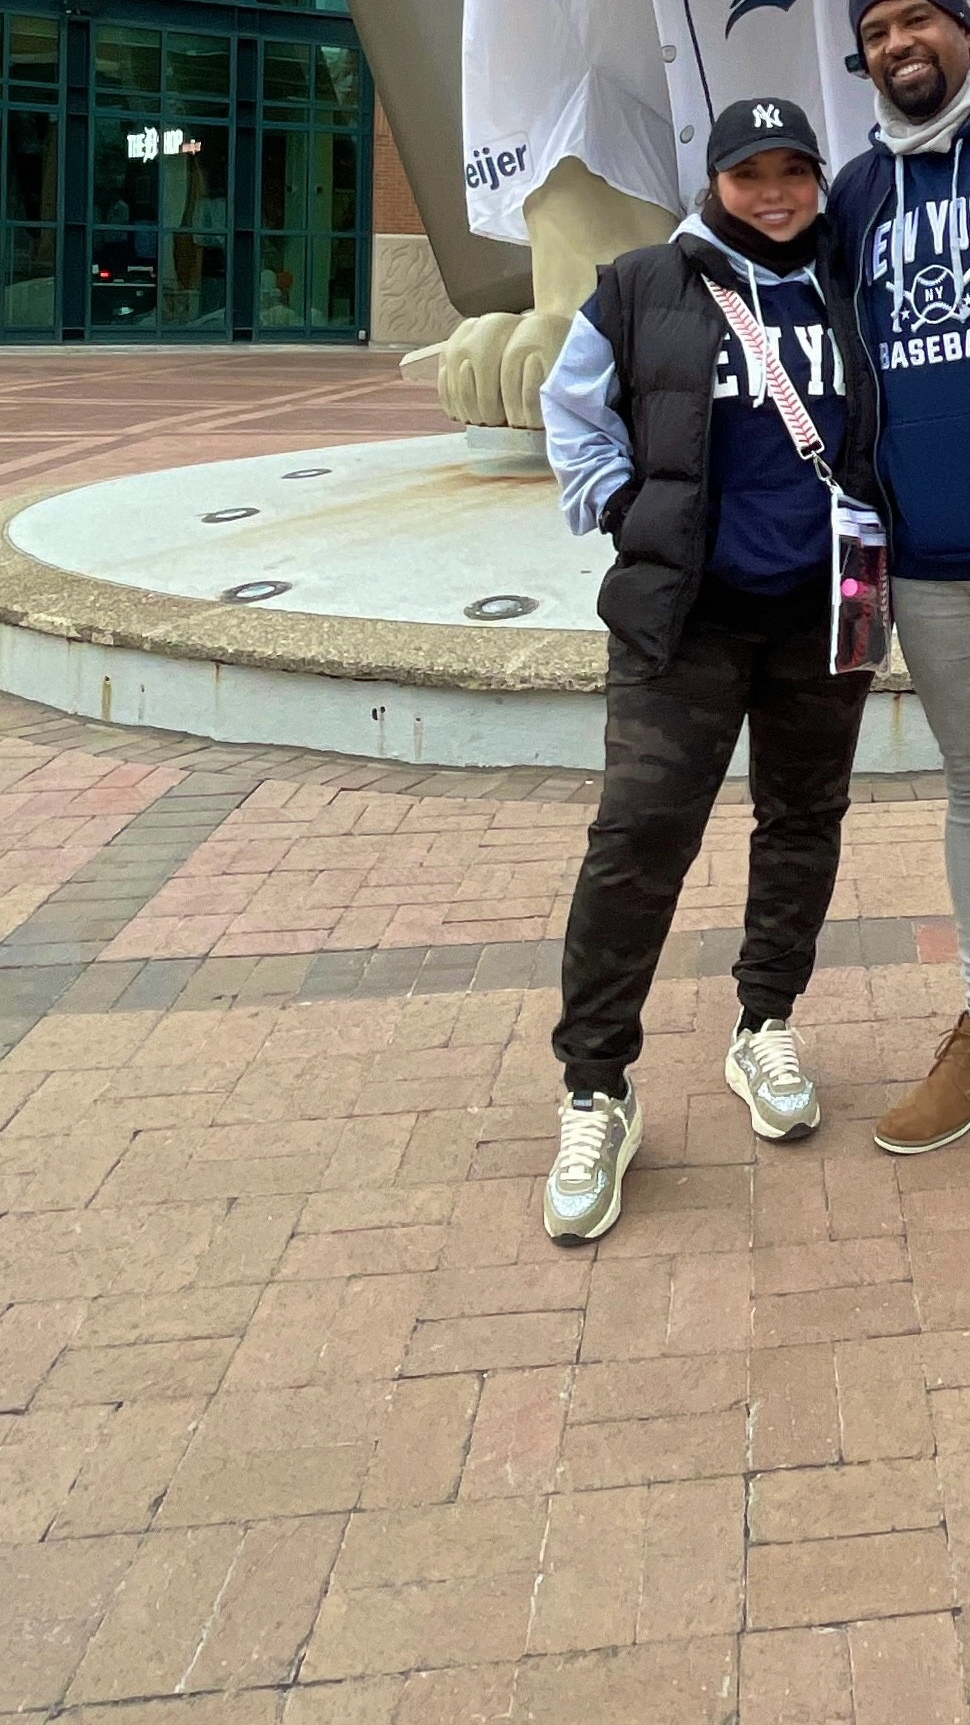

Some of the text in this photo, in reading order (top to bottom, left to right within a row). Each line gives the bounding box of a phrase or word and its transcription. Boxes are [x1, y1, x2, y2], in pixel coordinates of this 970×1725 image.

[752, 104, 784, 128] NY
[466, 144, 527, 191] eijer
[872, 207, 919, 282] EW
[924, 286, 944, 303] NY
